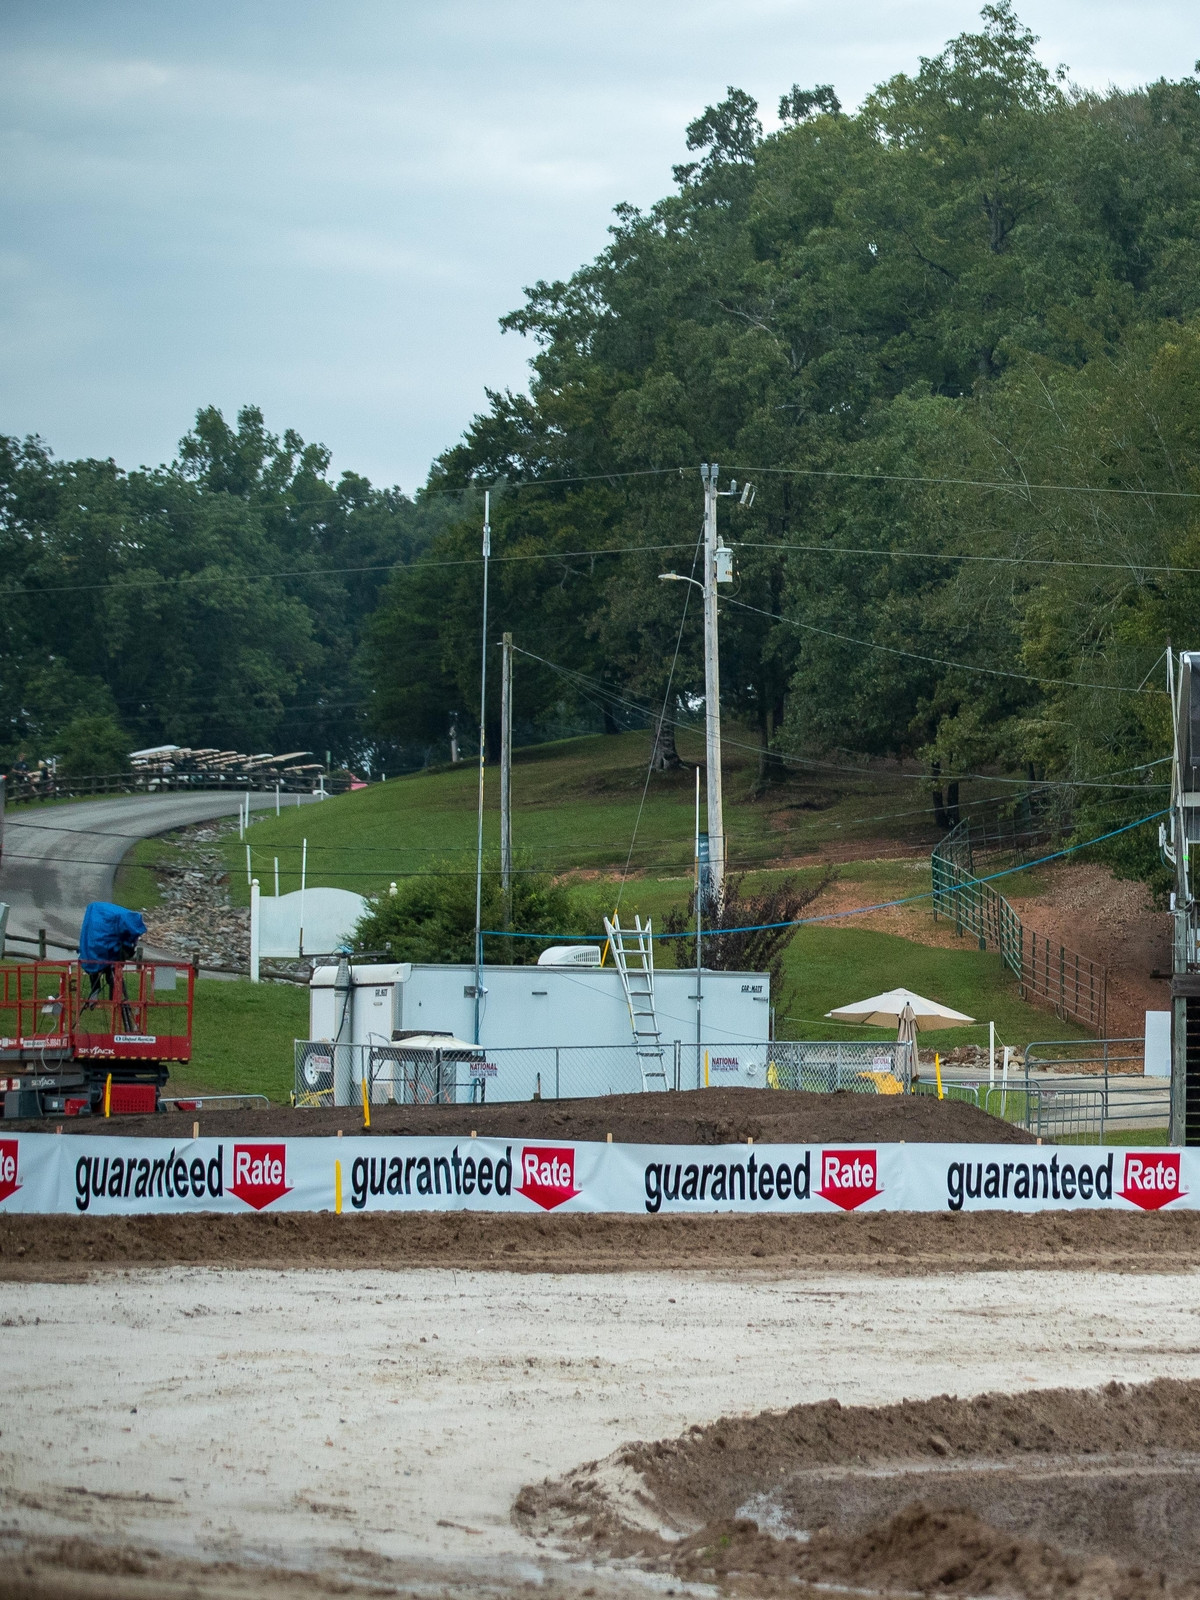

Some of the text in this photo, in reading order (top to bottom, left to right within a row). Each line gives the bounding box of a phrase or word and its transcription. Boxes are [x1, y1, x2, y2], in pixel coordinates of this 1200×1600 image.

[79, 1046, 115, 1055] SKYJACK
[76, 1145, 283, 1211] guaranteed Rate
[352, 1147, 571, 1210] guaranteed Rate
[645, 1152, 874, 1213] guaranteed Rate
[948, 1153, 1178, 1211] guaranteed Rate
